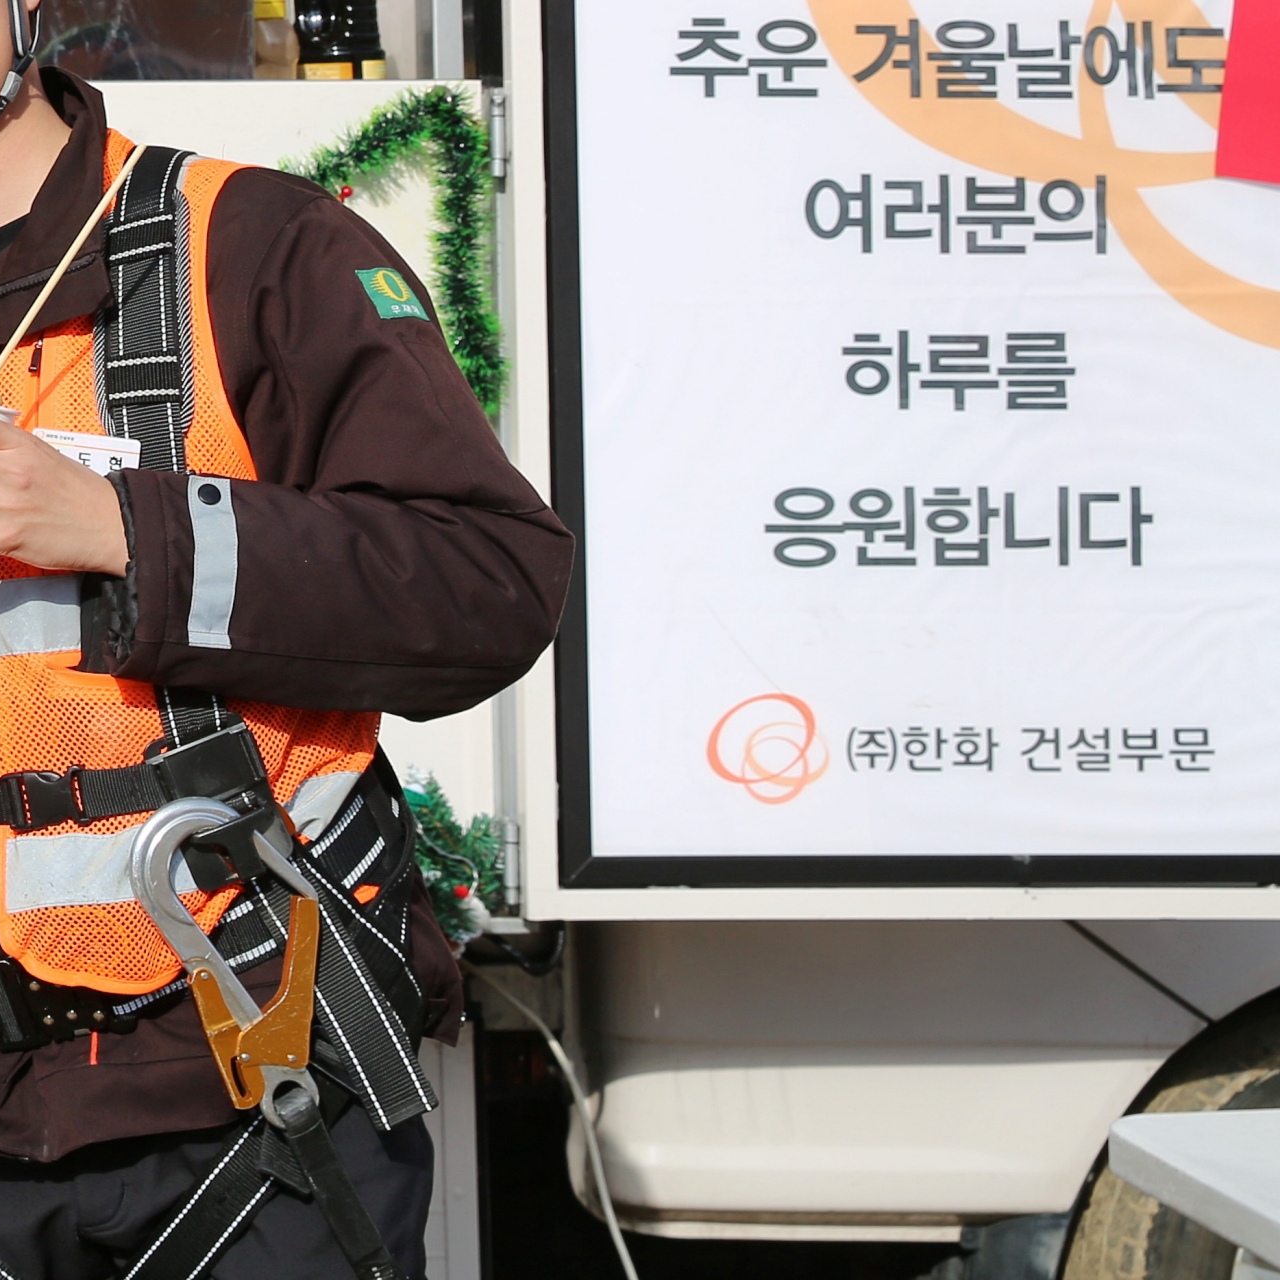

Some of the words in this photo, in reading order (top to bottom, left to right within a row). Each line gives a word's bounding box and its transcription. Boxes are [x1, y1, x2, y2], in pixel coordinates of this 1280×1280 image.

[669, 17, 828, 98] 추운
[852, 18, 1227, 100] 겨울날에도
[804, 173, 1107, 255] 여러분의
[841, 329, 1077, 411] 하루를
[764, 485, 1154, 568] 응원합니다
[1019, 725, 1216, 773] 건설부문
